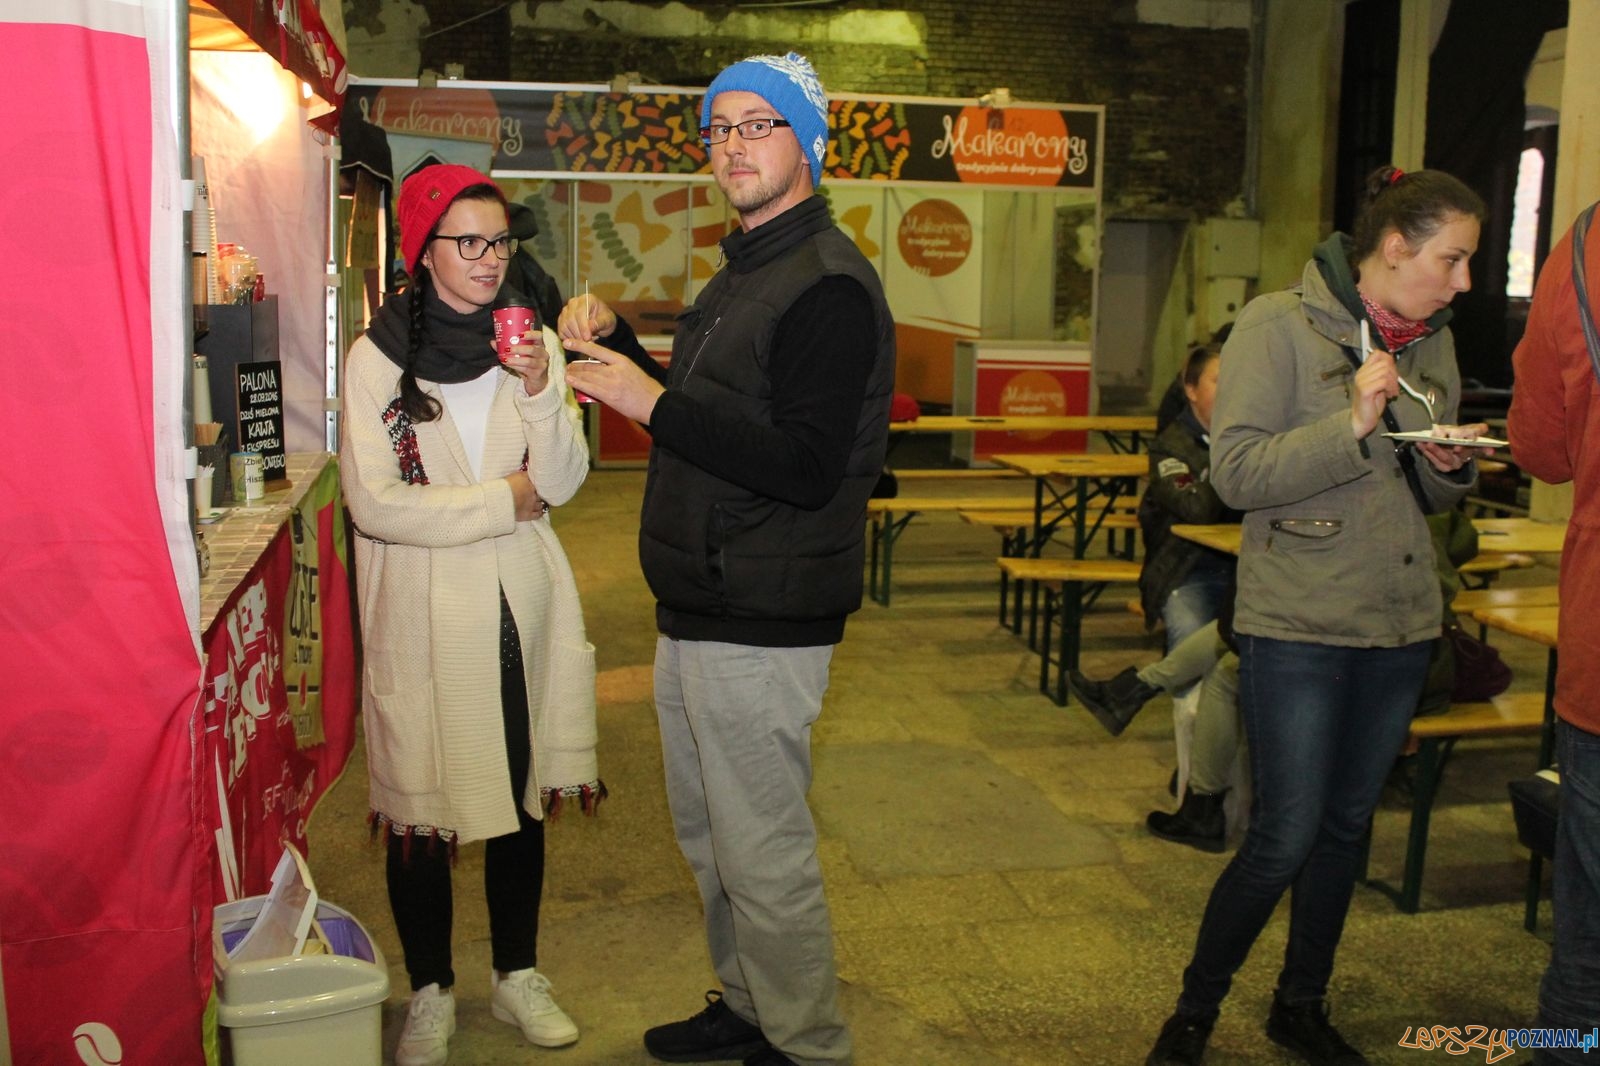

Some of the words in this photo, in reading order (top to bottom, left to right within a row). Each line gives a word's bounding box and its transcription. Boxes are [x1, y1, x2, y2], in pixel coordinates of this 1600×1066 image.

[931, 115, 1088, 175] Makarony
[240, 369, 277, 393] PALONA
[248, 419, 275, 438] KAWA
[246, 438, 280, 452] EKSPRESU
